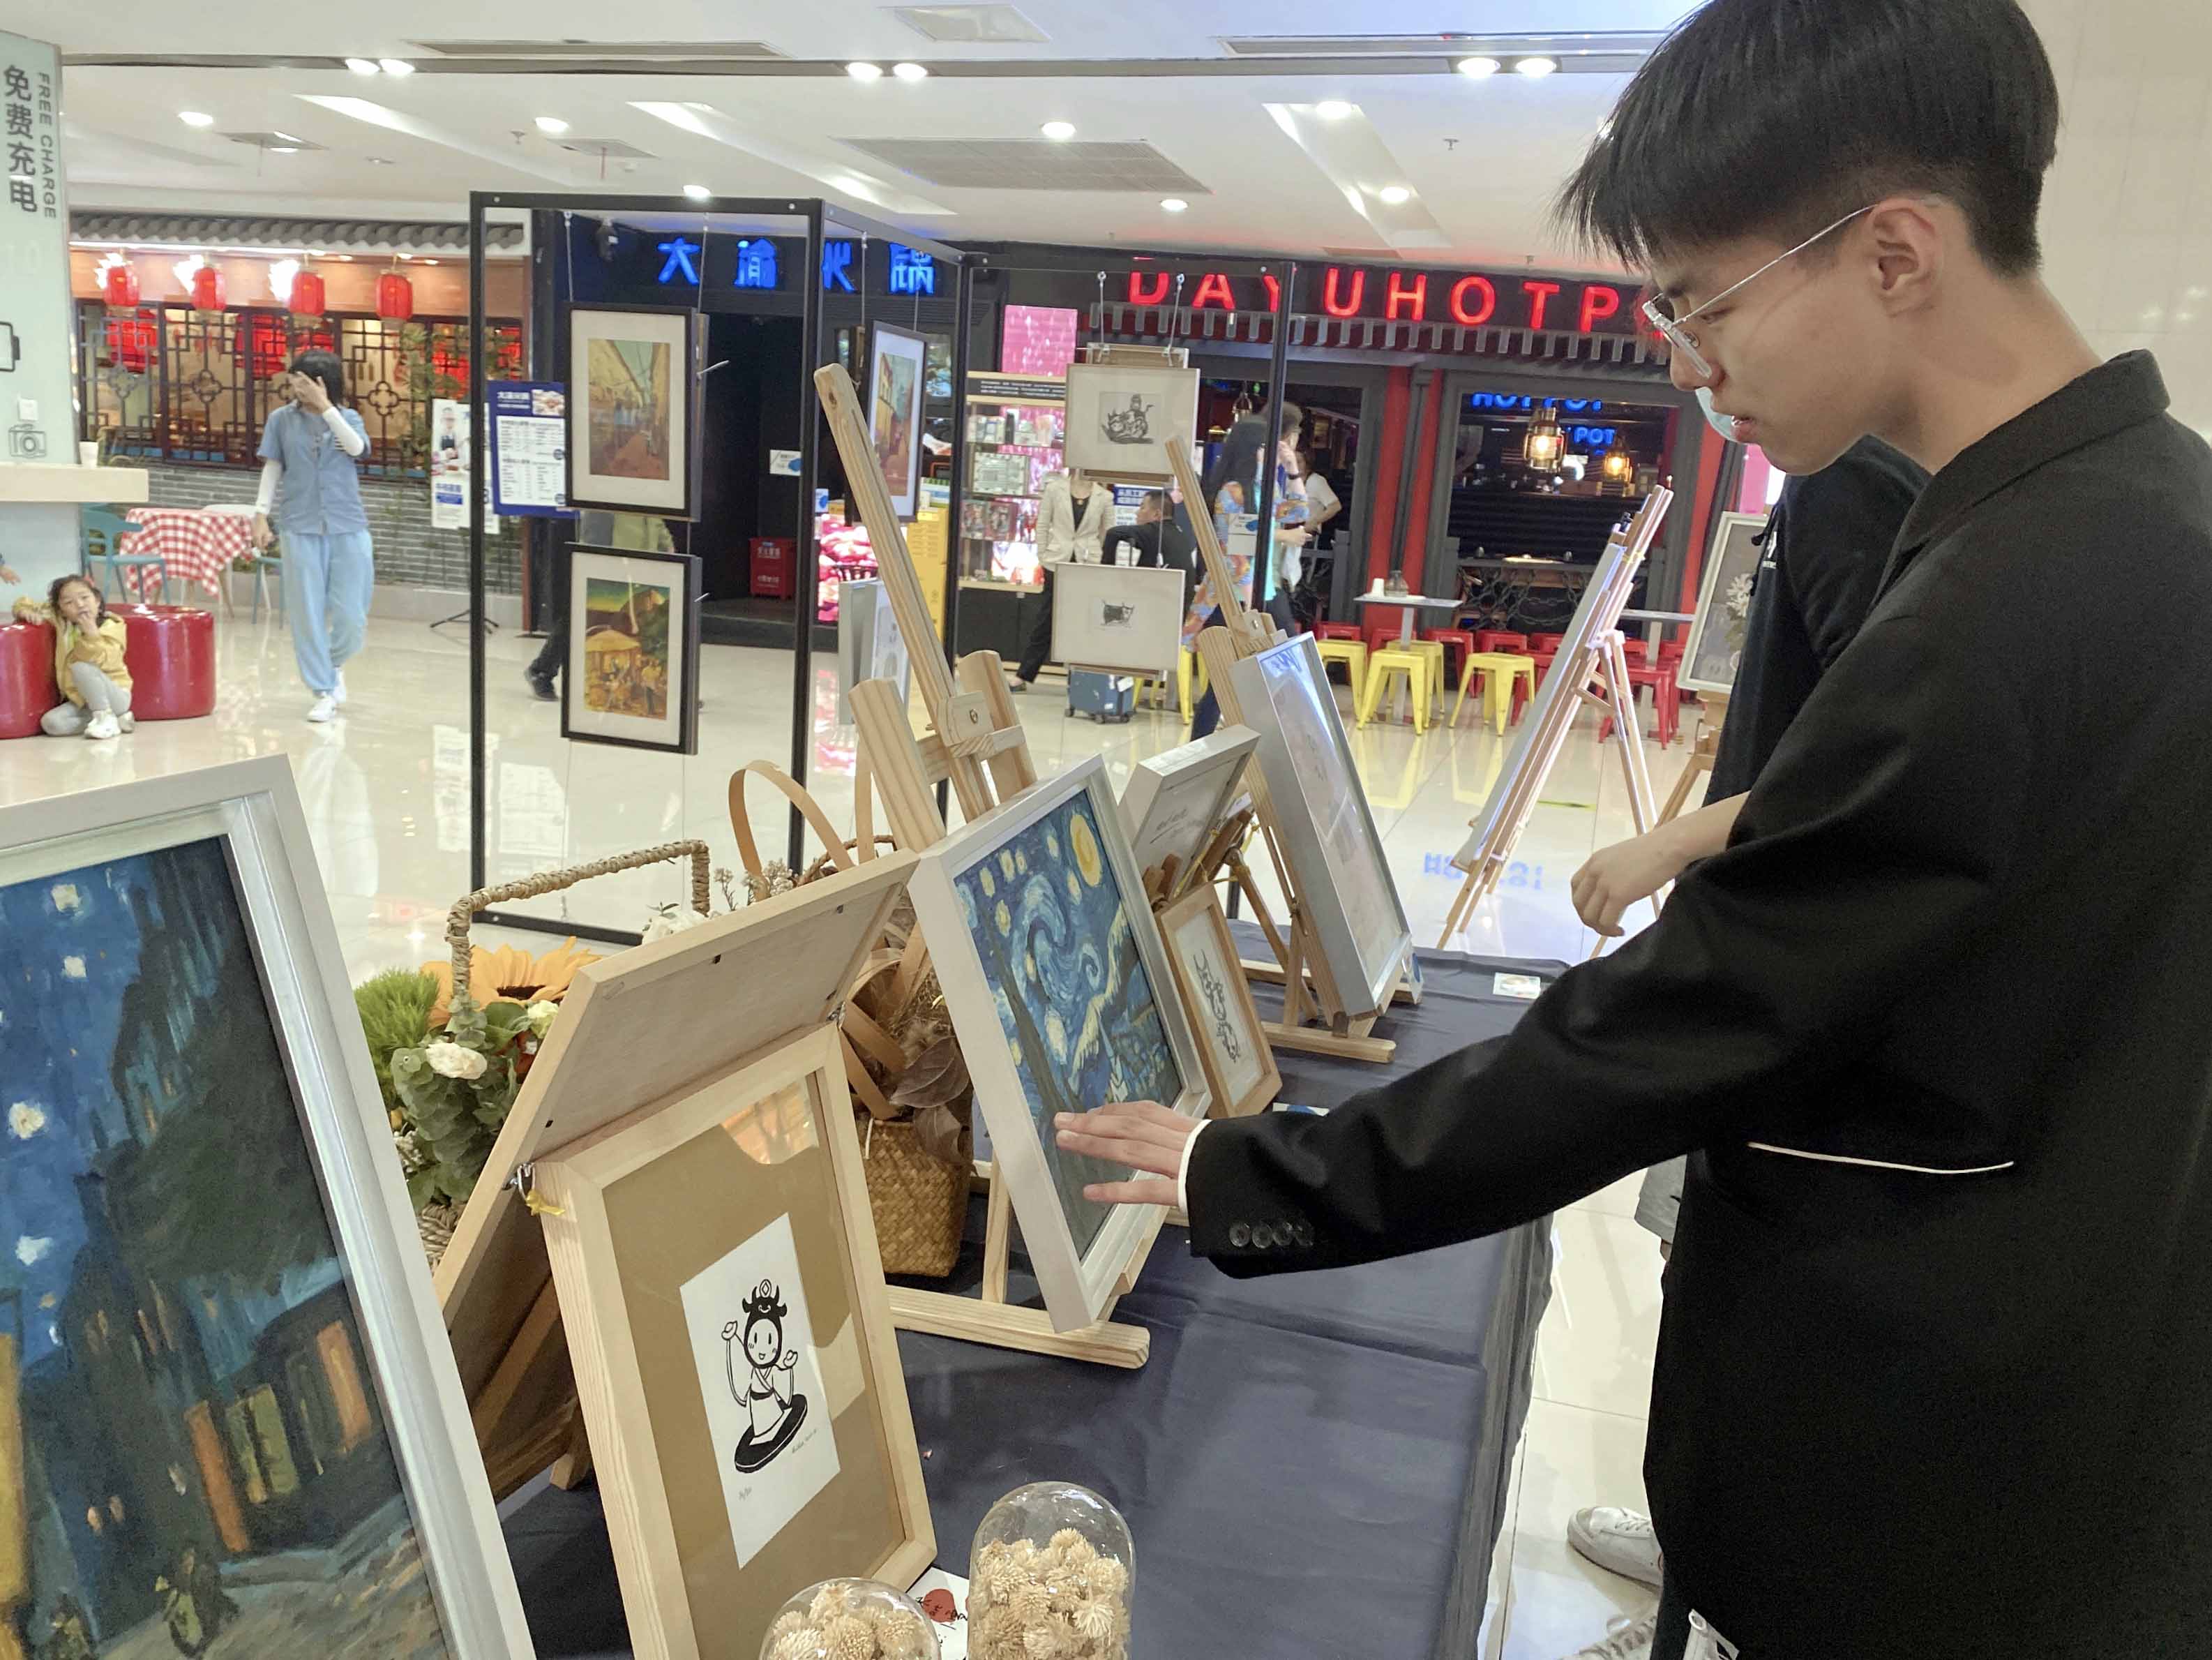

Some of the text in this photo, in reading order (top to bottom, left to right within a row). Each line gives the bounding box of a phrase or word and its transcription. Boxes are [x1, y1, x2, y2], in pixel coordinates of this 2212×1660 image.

[3, 65, 37, 212] 免费充电
[38, 72, 57, 218] FREE CHARGE
[657, 237, 935, 294] 大渝火锅
[1128, 256, 1667, 342] DAYUHOTP
